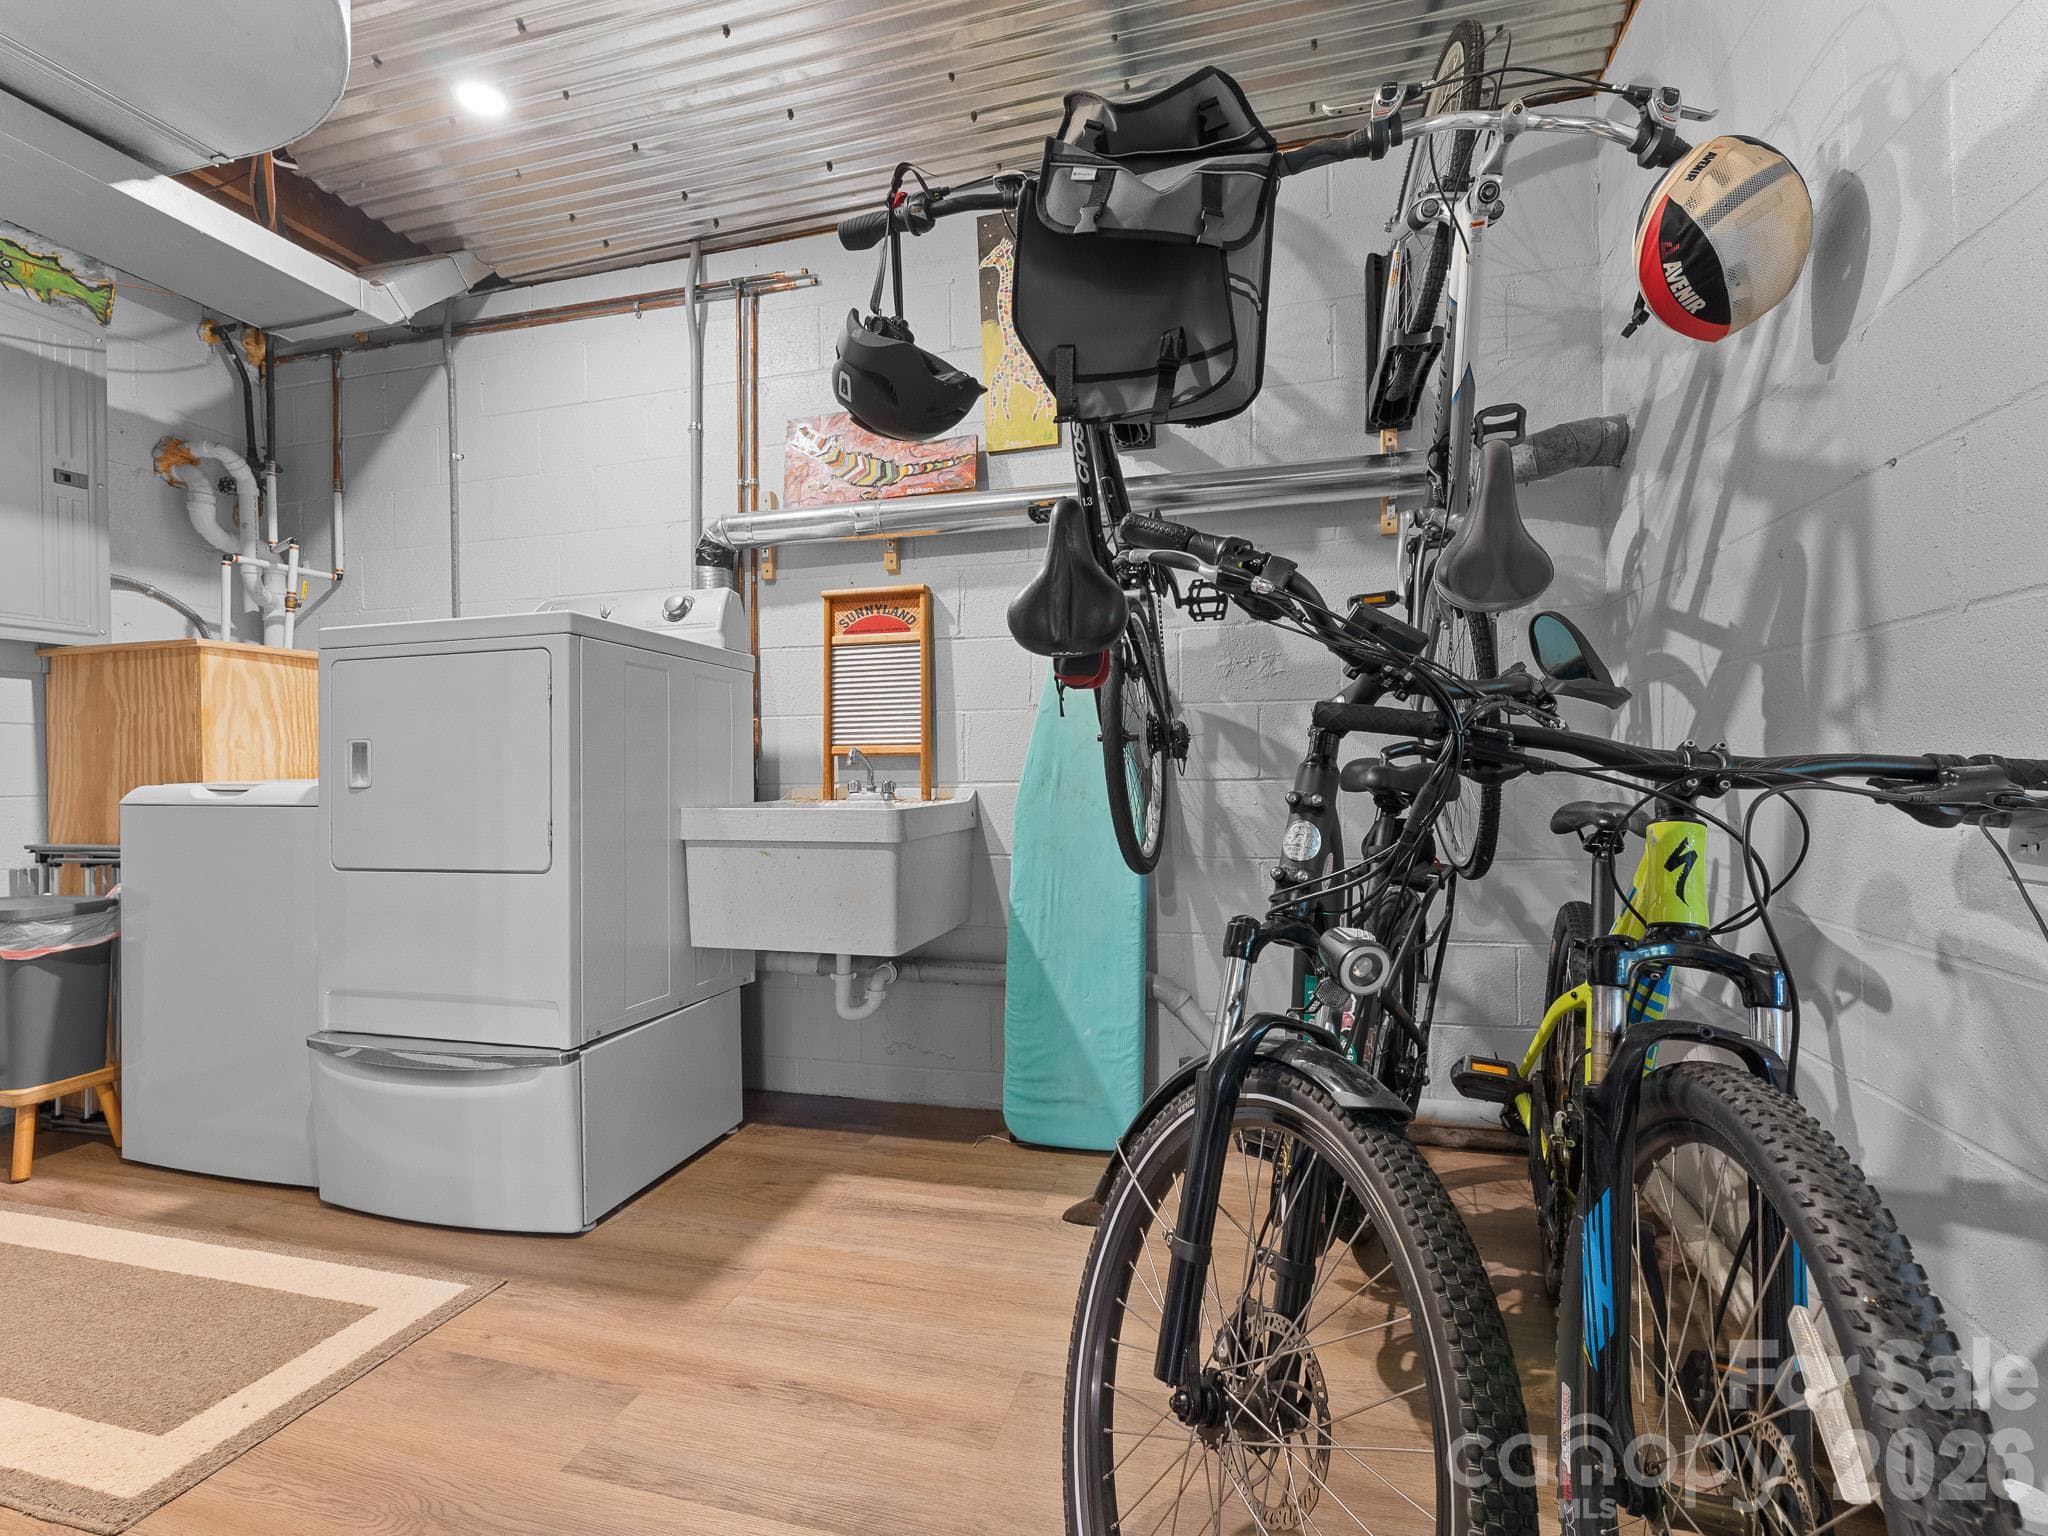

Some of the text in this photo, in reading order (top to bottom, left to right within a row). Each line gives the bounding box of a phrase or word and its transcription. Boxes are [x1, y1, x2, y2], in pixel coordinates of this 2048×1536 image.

[1684, 151, 1718, 182] AVENIR
[1662, 260, 1707, 315] AVENIR
[838, 604, 917, 629] SUNNYLAND
